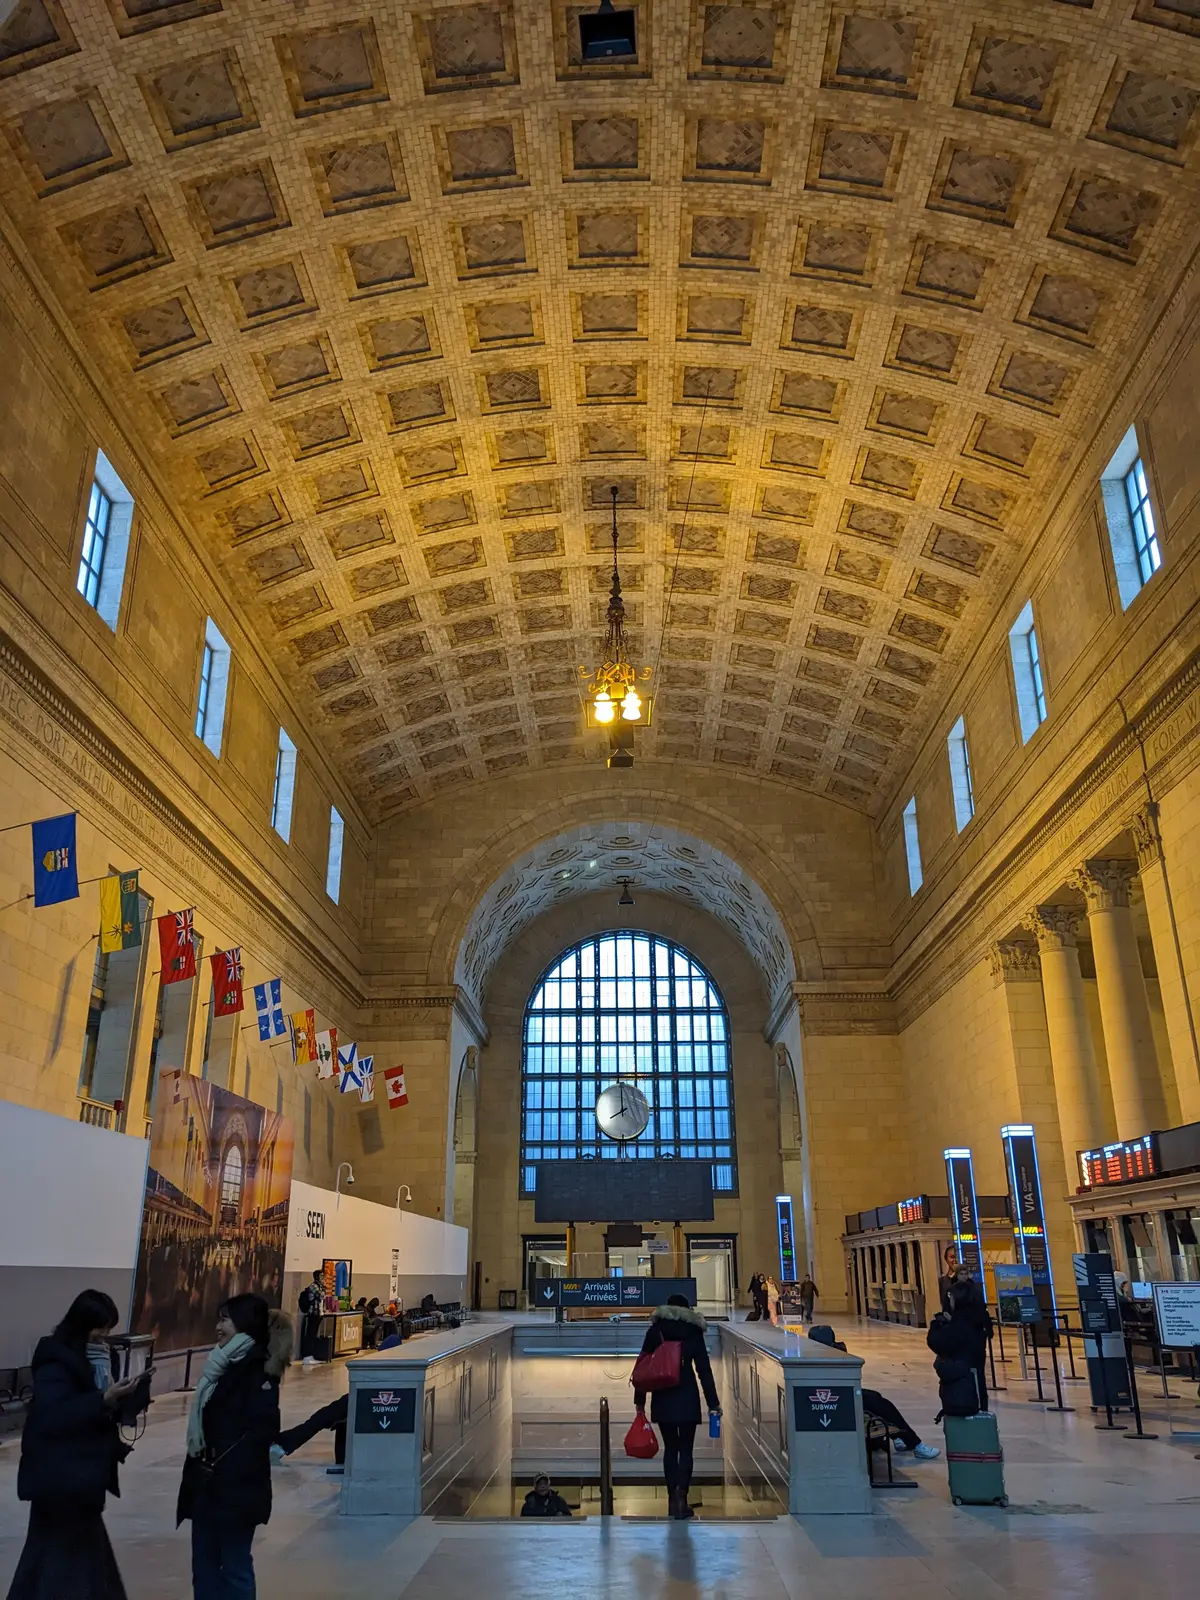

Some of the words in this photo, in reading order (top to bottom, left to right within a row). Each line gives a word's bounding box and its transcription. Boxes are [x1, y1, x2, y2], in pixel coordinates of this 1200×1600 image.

[35, 714, 115, 800] PORT-ARTHUR
[1089, 766, 1129, 820] SUDBURY
[1152, 695, 1200, 759] FORT-W
[1024, 1192, 1035, 1213] VIA
[962, 1206, 972, 1223] VIA
[584, 1282, 616, 1291] Arrivals
[584, 1292, 618, 1301] Arrivées
[343, 1322, 359, 1342] Union
